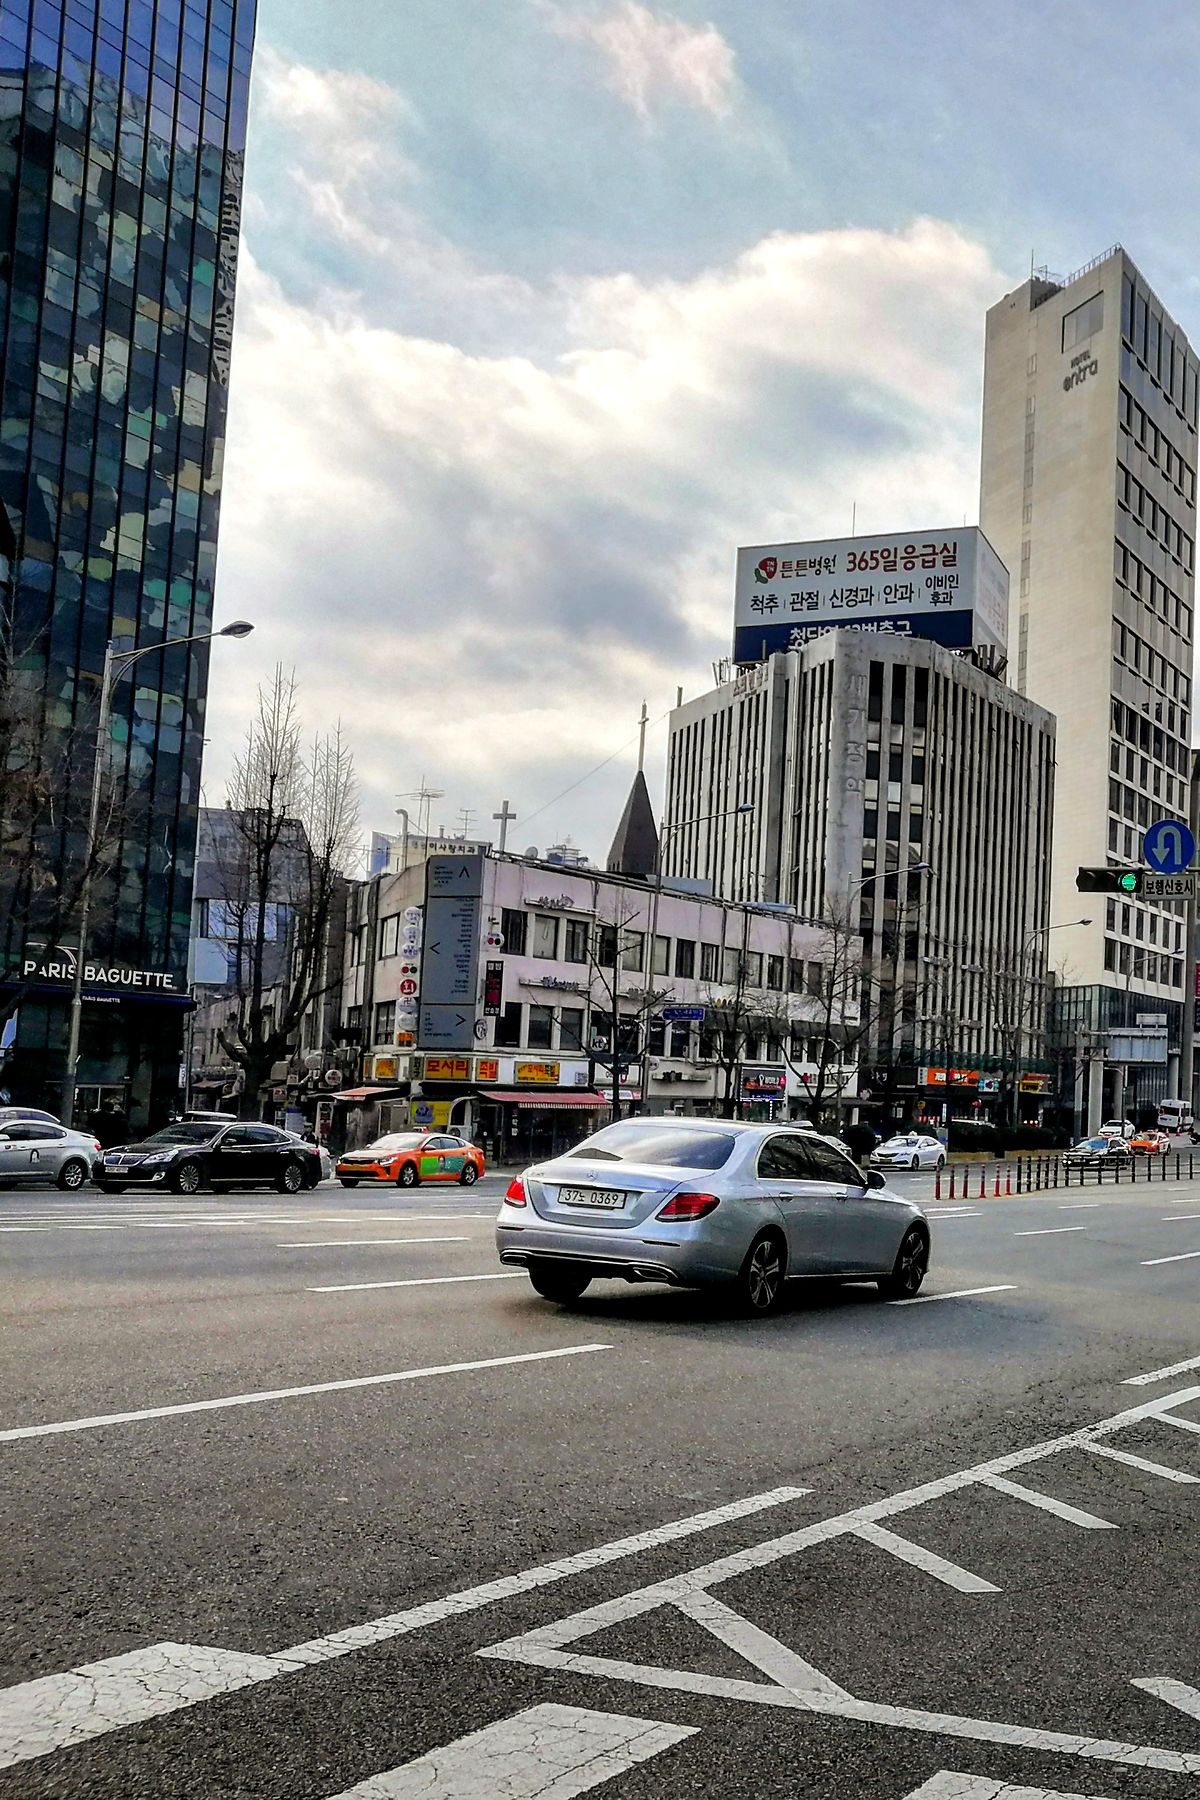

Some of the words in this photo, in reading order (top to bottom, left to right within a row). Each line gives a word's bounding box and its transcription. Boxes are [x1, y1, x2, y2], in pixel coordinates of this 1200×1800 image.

[1071, 350, 1091, 369] HOTEL
[1063, 359, 1098, 391] entra
[780, 554, 837, 579] 튼튼병원
[846, 542, 957, 572] 365일응급실
[750, 593, 779, 615] 척추
[789, 589, 819, 612] 관절
[828, 585, 875, 608] 신경과
[883, 582, 914, 604] 안과
[1145, 879, 1193, 896] 보행신호시
[84, 966, 174, 988] BAGUETTE
[426, 1058, 469, 1078] 모서리
[479, 1060, 498, 1079] 족발
[591, 1192, 618, 1205] 0369
